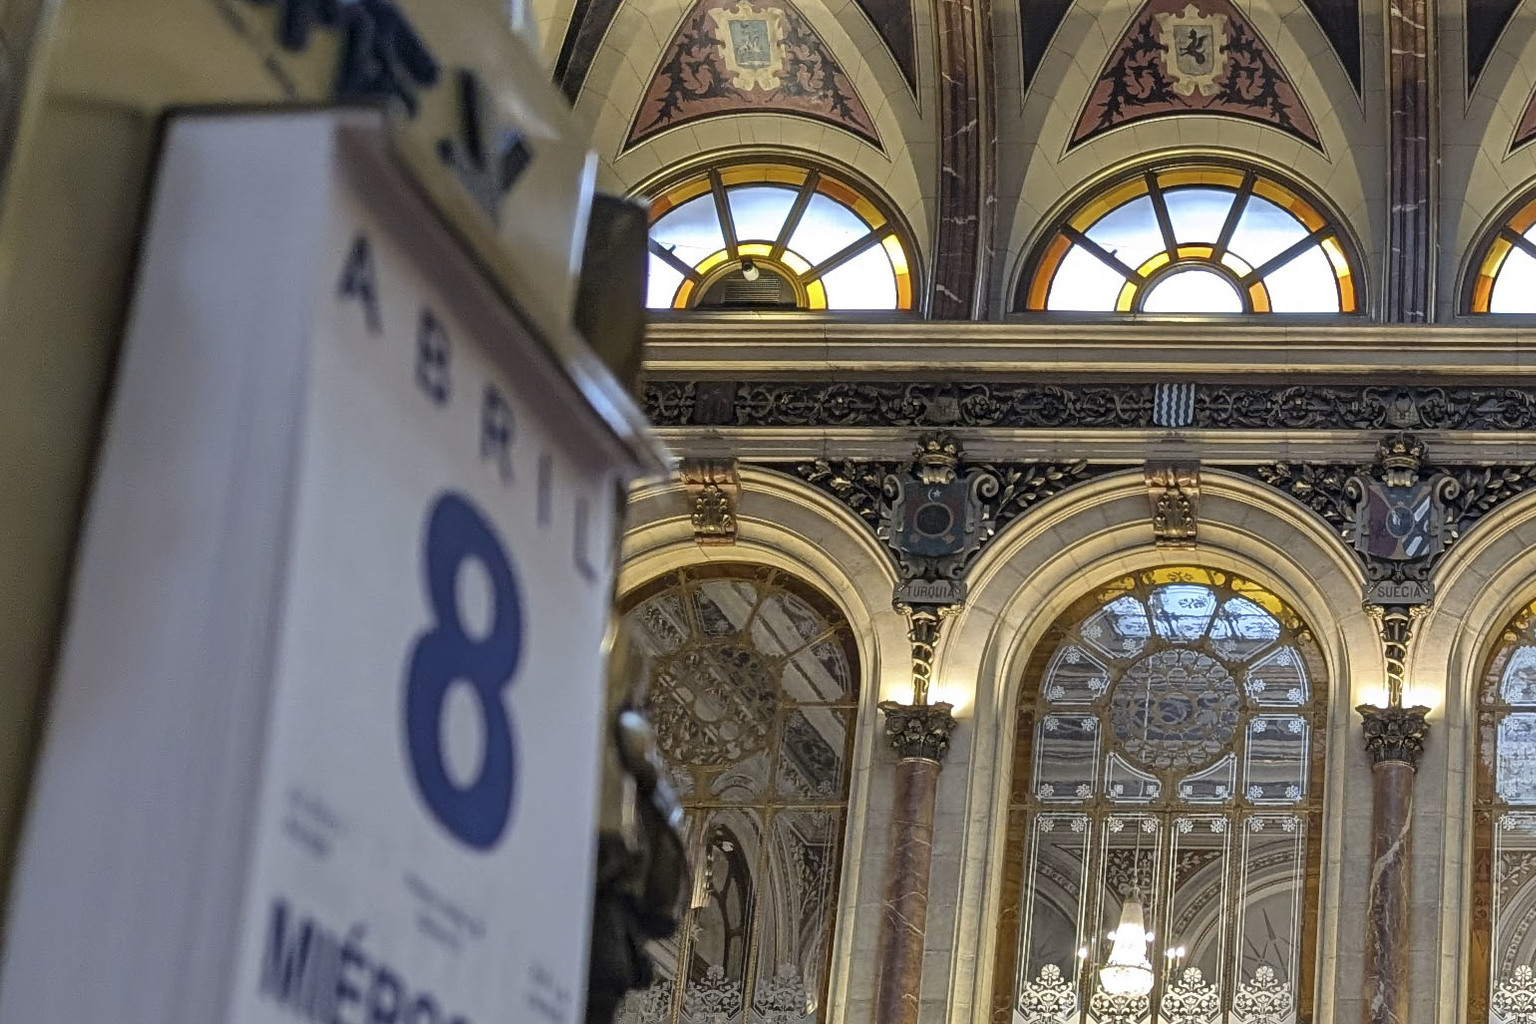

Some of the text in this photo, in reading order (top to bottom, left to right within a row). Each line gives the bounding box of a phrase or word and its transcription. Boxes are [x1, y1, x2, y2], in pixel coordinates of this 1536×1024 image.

[338, 230, 598, 584] ABRIL
[404, 490, 524, 851] 8
[907, 586, 955, 599] TURQUIA
[1378, 587, 1421, 597] SUECIA
